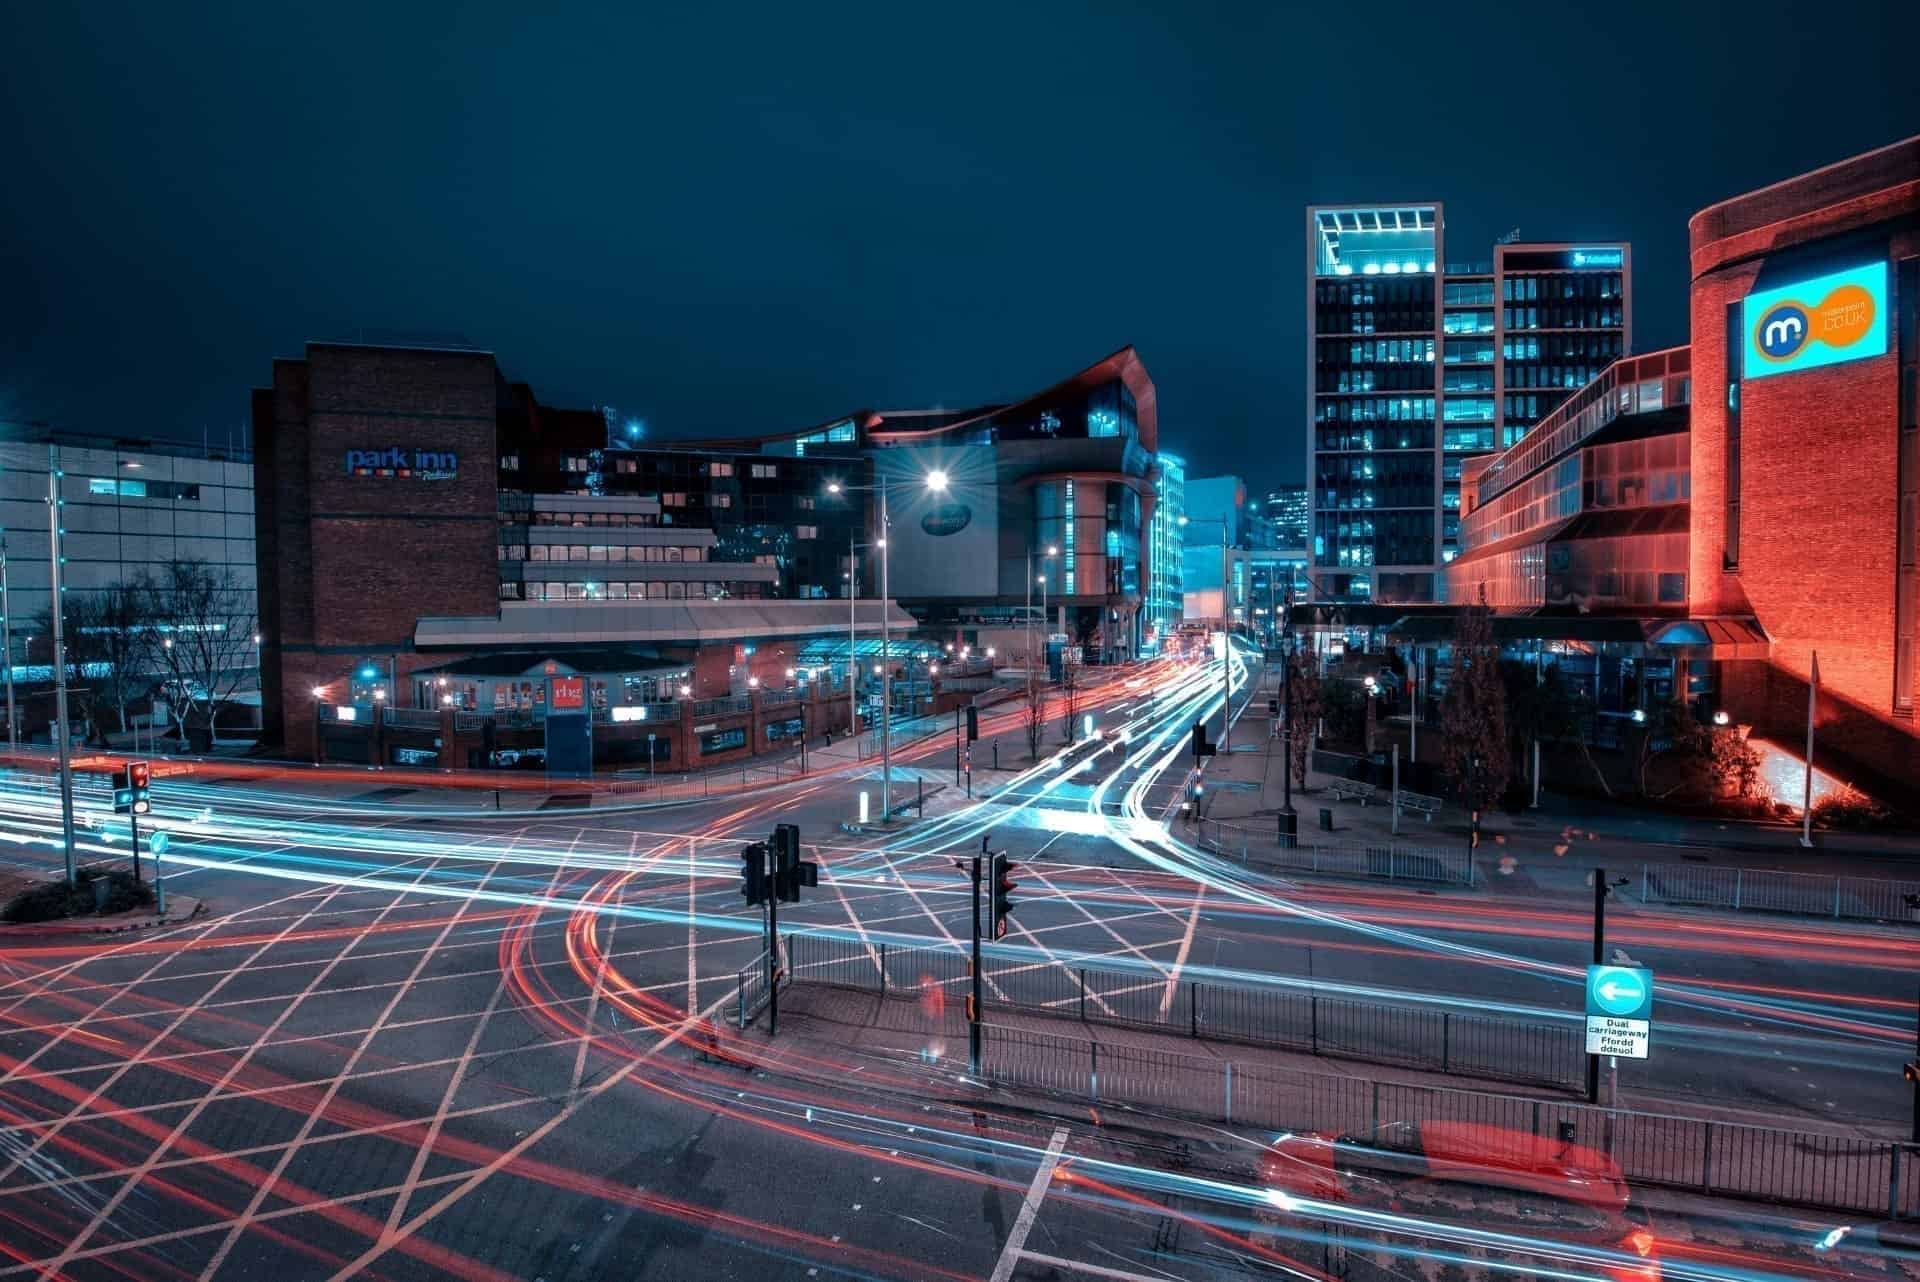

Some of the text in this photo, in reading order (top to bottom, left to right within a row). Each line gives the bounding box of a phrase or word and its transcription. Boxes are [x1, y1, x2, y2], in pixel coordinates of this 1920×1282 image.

[346, 447, 457, 474] park inn
[1607, 1019, 1629, 1028] Dual
[1588, 1027, 1647, 1039] carriageway
[1601, 1036, 1634, 1047] Ffordd
[1600, 1045, 1633, 1055] ddeuol
